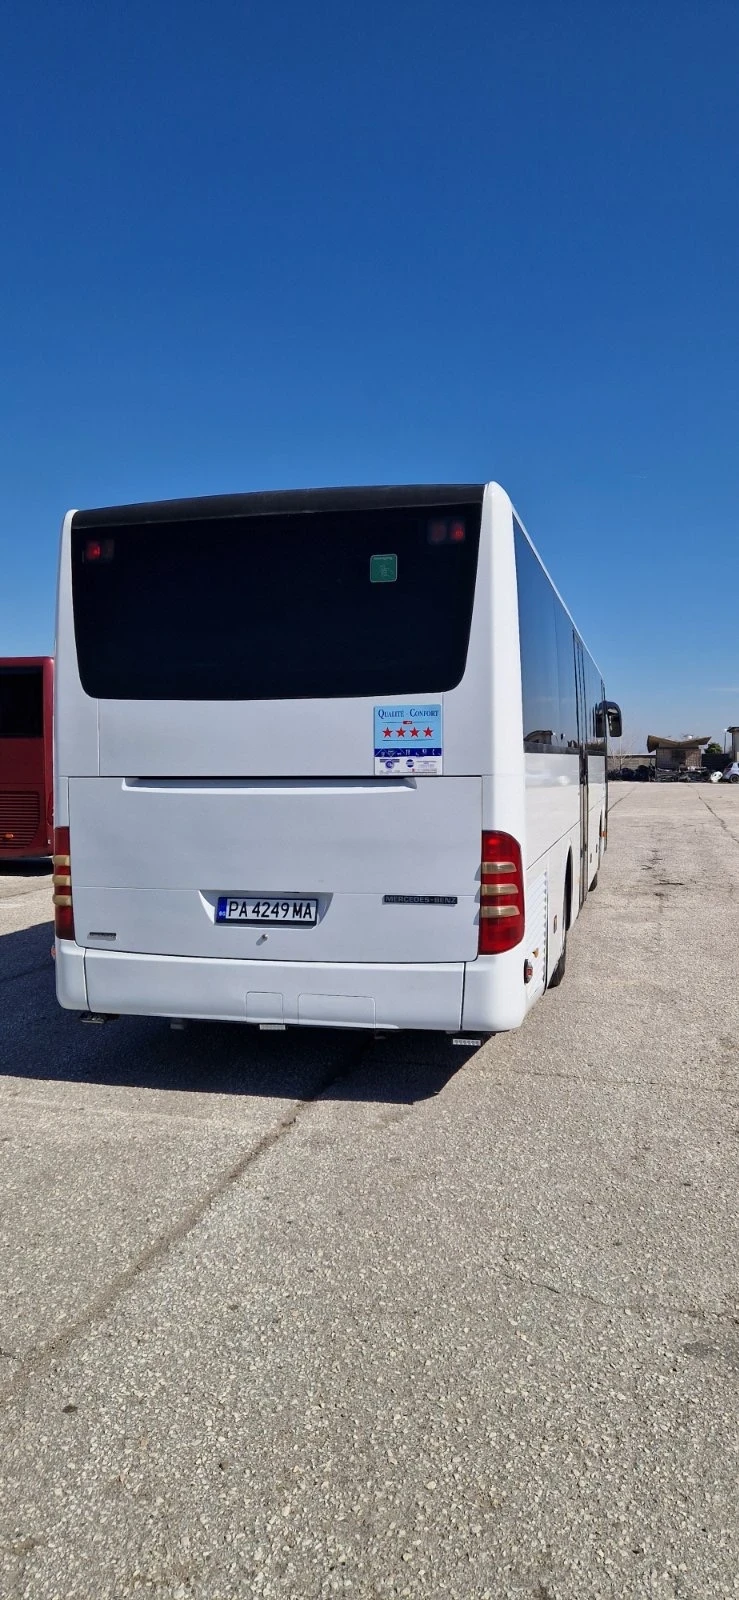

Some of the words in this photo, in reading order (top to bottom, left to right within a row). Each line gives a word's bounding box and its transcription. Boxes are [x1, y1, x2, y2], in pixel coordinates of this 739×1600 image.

[409, 708, 439, 717] CONFORT
[385, 895, 456, 904] MERCEDES-BENZ
[228, 901, 248, 917] PA
[252, 902, 290, 918] 4249
[292, 902, 312, 919] MA
